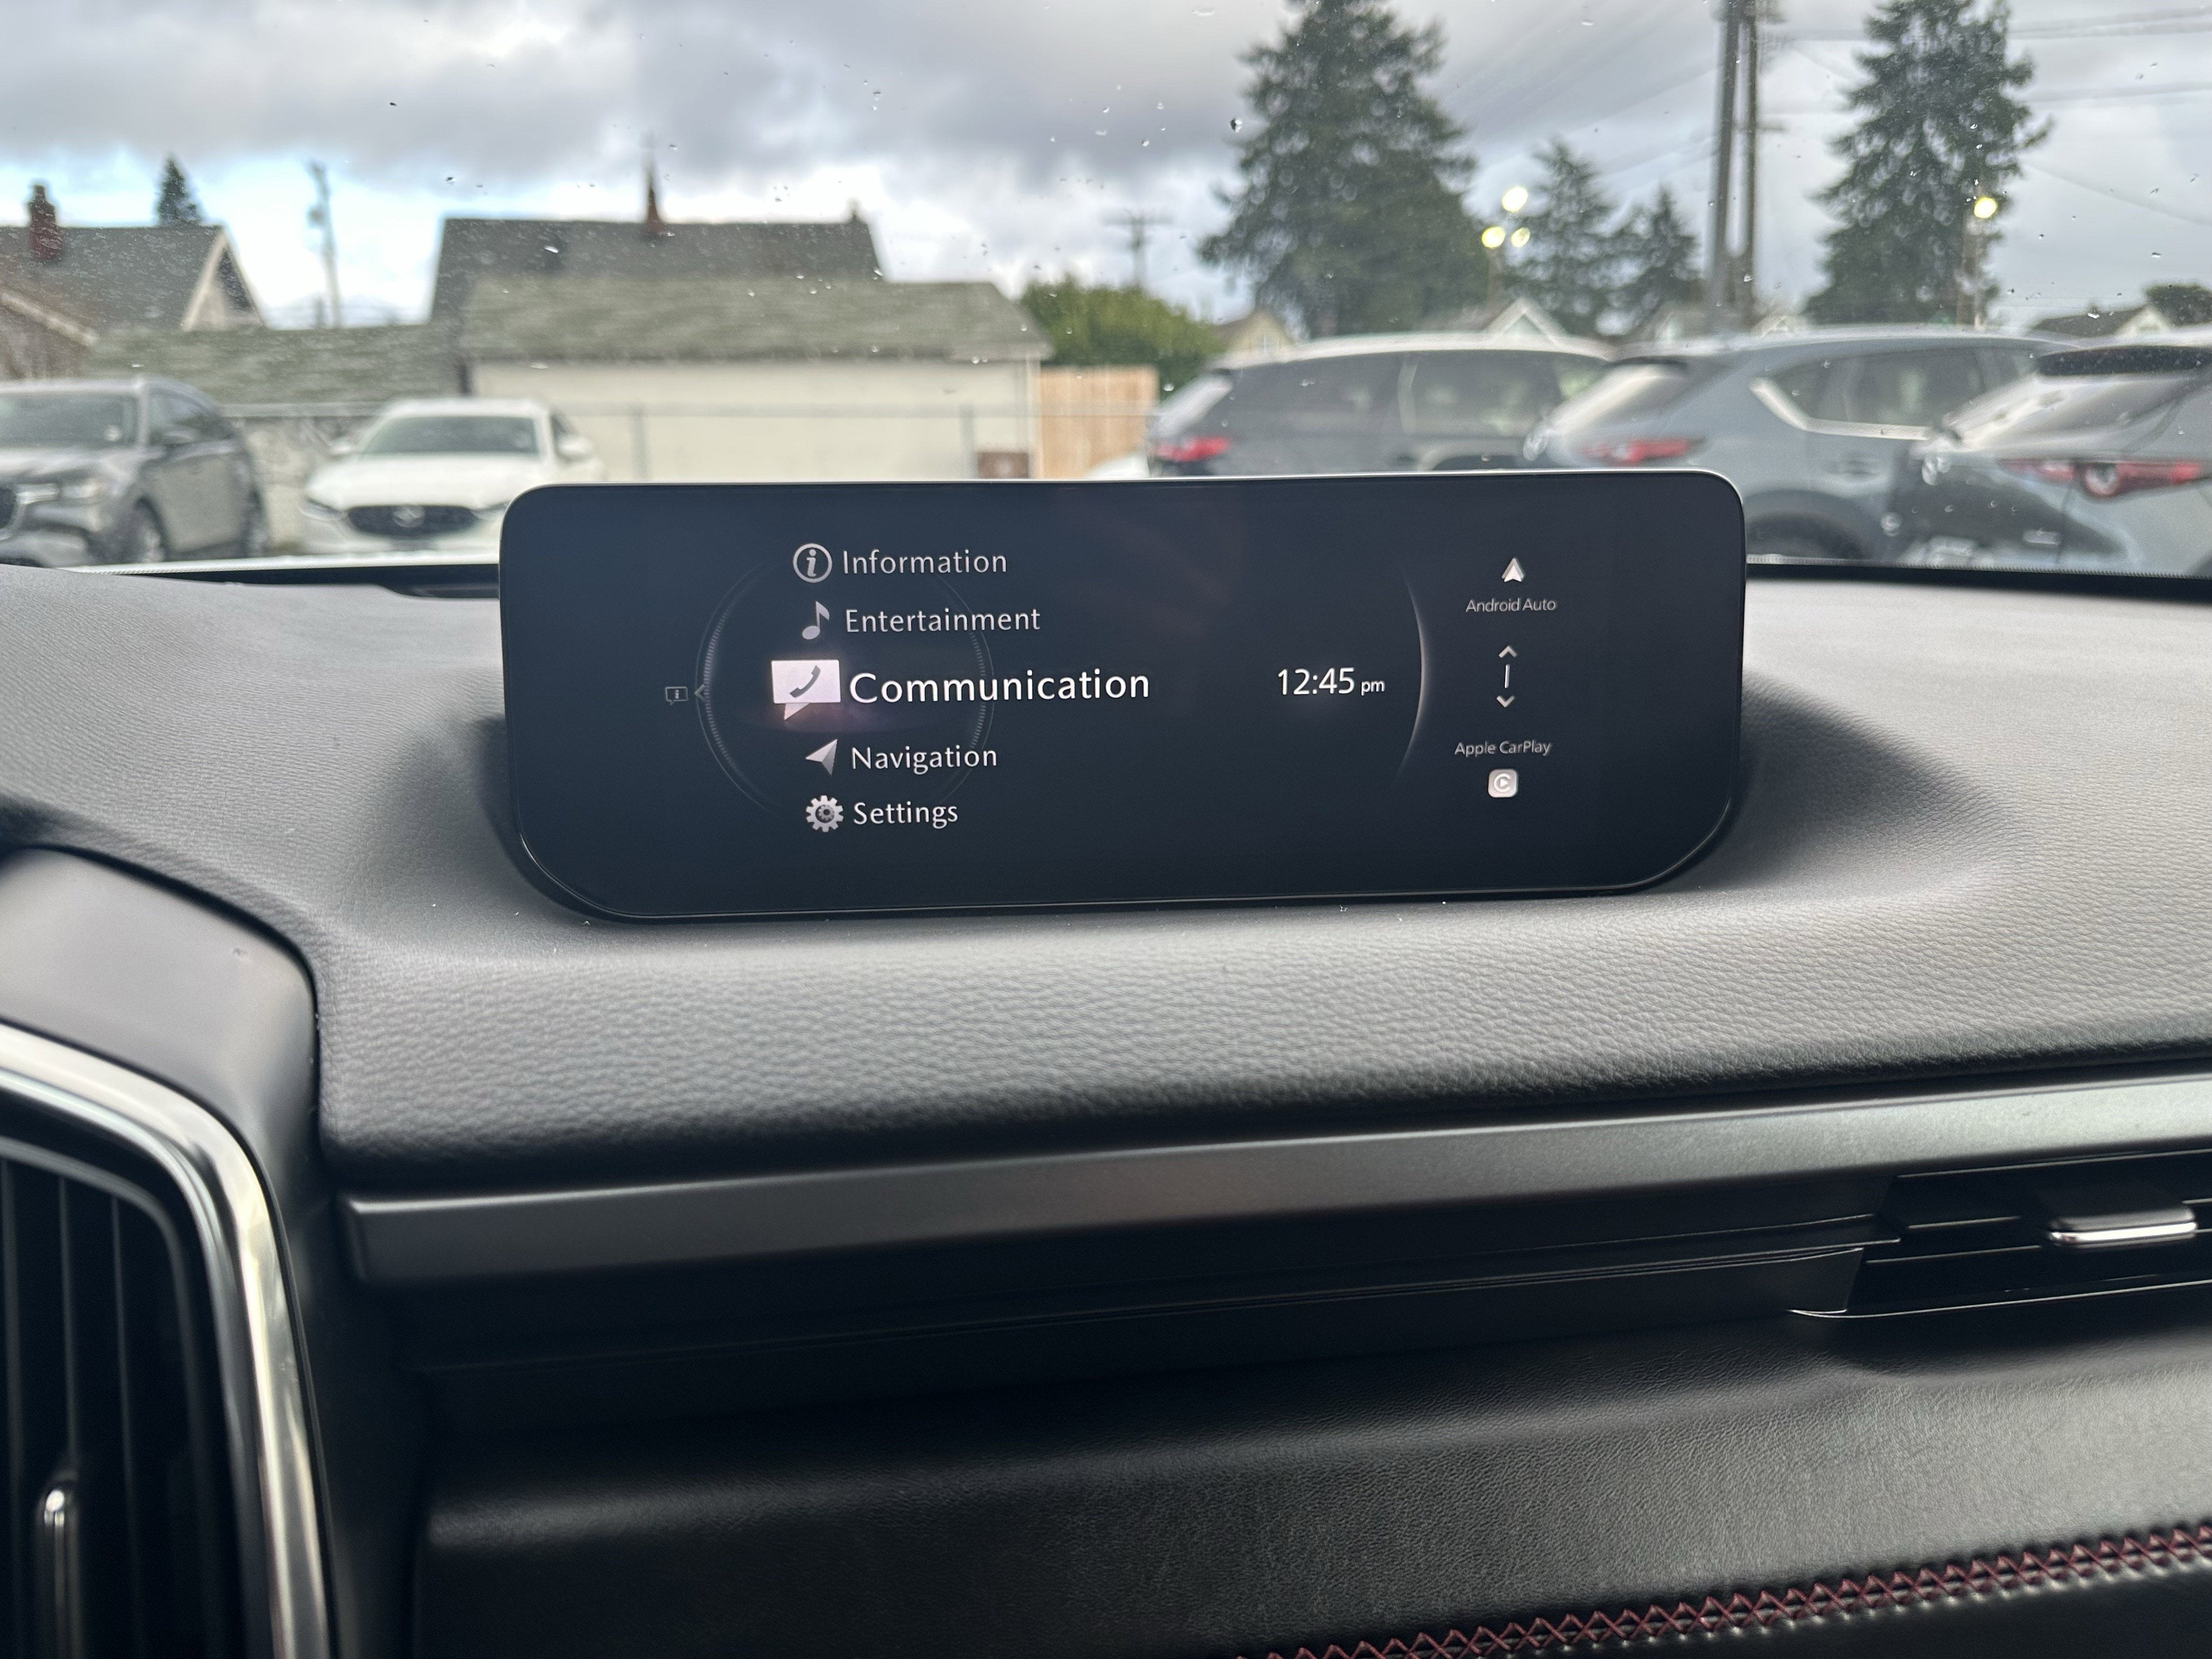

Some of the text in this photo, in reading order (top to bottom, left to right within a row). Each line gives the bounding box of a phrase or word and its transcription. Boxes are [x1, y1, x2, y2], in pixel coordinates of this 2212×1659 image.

[843, 548, 1007, 574] Information
[1465, 597, 1556, 612] Android Auto
[846, 608, 1041, 633] Entertainment
[849, 668, 1149, 703] Communication
[1277, 667, 1385, 696] 12:45 pm
[851, 744, 997, 775] Navigation
[1454, 740, 1552, 758] Apple CarPlay
[854, 800, 958, 829] Settings
